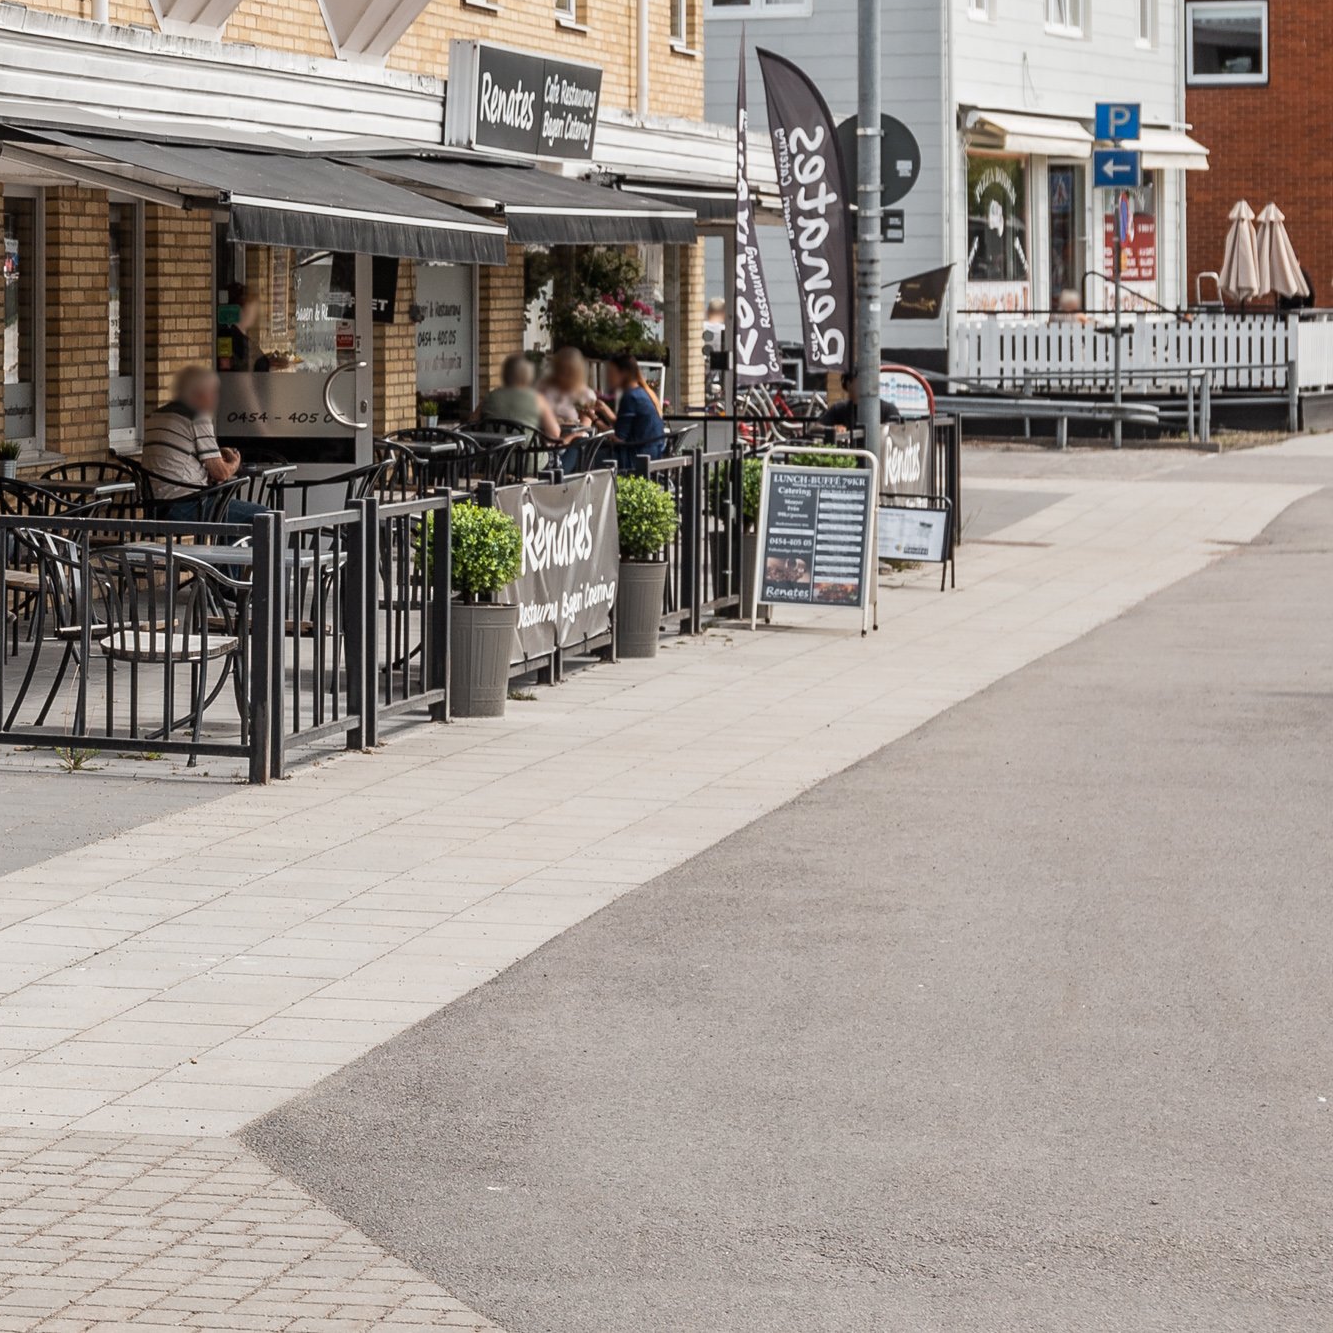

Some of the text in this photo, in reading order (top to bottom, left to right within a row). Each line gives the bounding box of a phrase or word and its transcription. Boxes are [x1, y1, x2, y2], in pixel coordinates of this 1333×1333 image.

[479, 71, 536, 131] Renates
[560, 79, 597, 118] Restaurang
[542, 110, 592, 151] Bageri Catering
[1109, 106, 1131, 137] P
[745, 246, 780, 373] Cafe Restaurang
[227, 412, 268, 424] 0454
[288, 412, 320, 424] 405
[884, 434, 921, 486] Renates
[774, 473, 841, 485] LUNCH-BUFFÉ
[778, 486, 812, 497] Catering
[520, 500, 593, 577] Renates
[803, 538, 813, 547] 05
[765, 585, 809, 598] Renates
